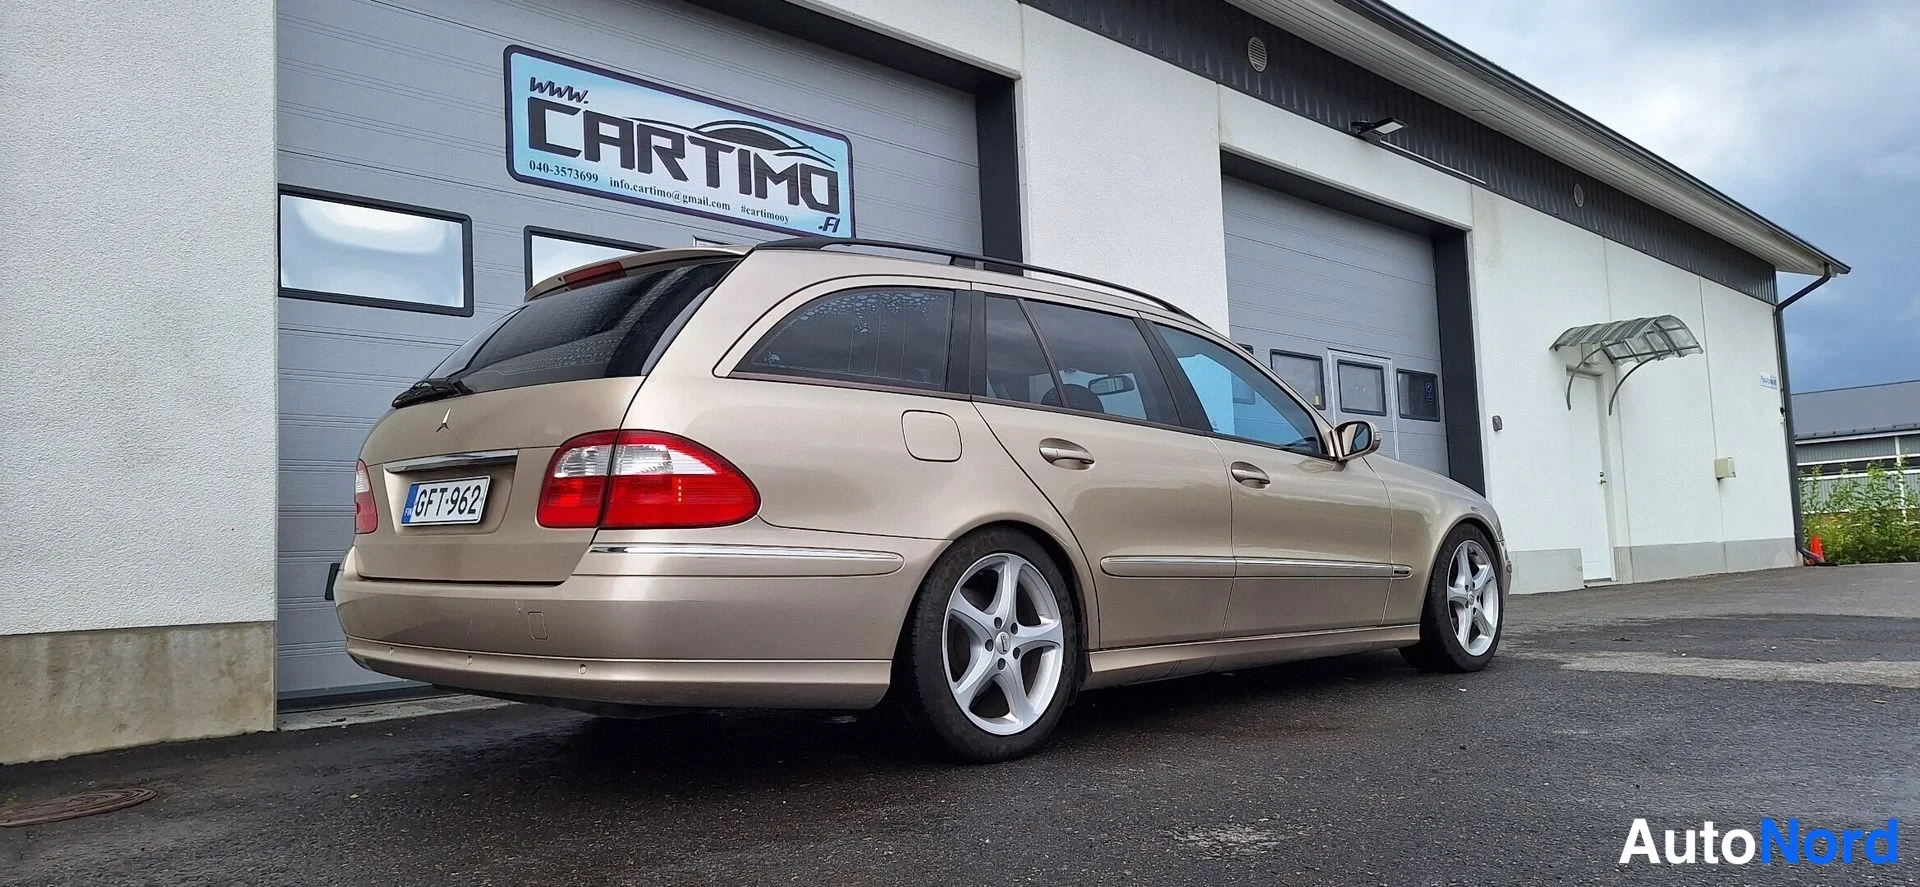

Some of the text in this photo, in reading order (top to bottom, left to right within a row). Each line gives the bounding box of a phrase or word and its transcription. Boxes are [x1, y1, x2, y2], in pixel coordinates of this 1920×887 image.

[528, 96, 840, 215] CARTIMO
[529, 159, 790, 224] 040-3573699 info.cartimo@gmail.com #cartimooy
[415, 484, 482, 517] GFT-962
